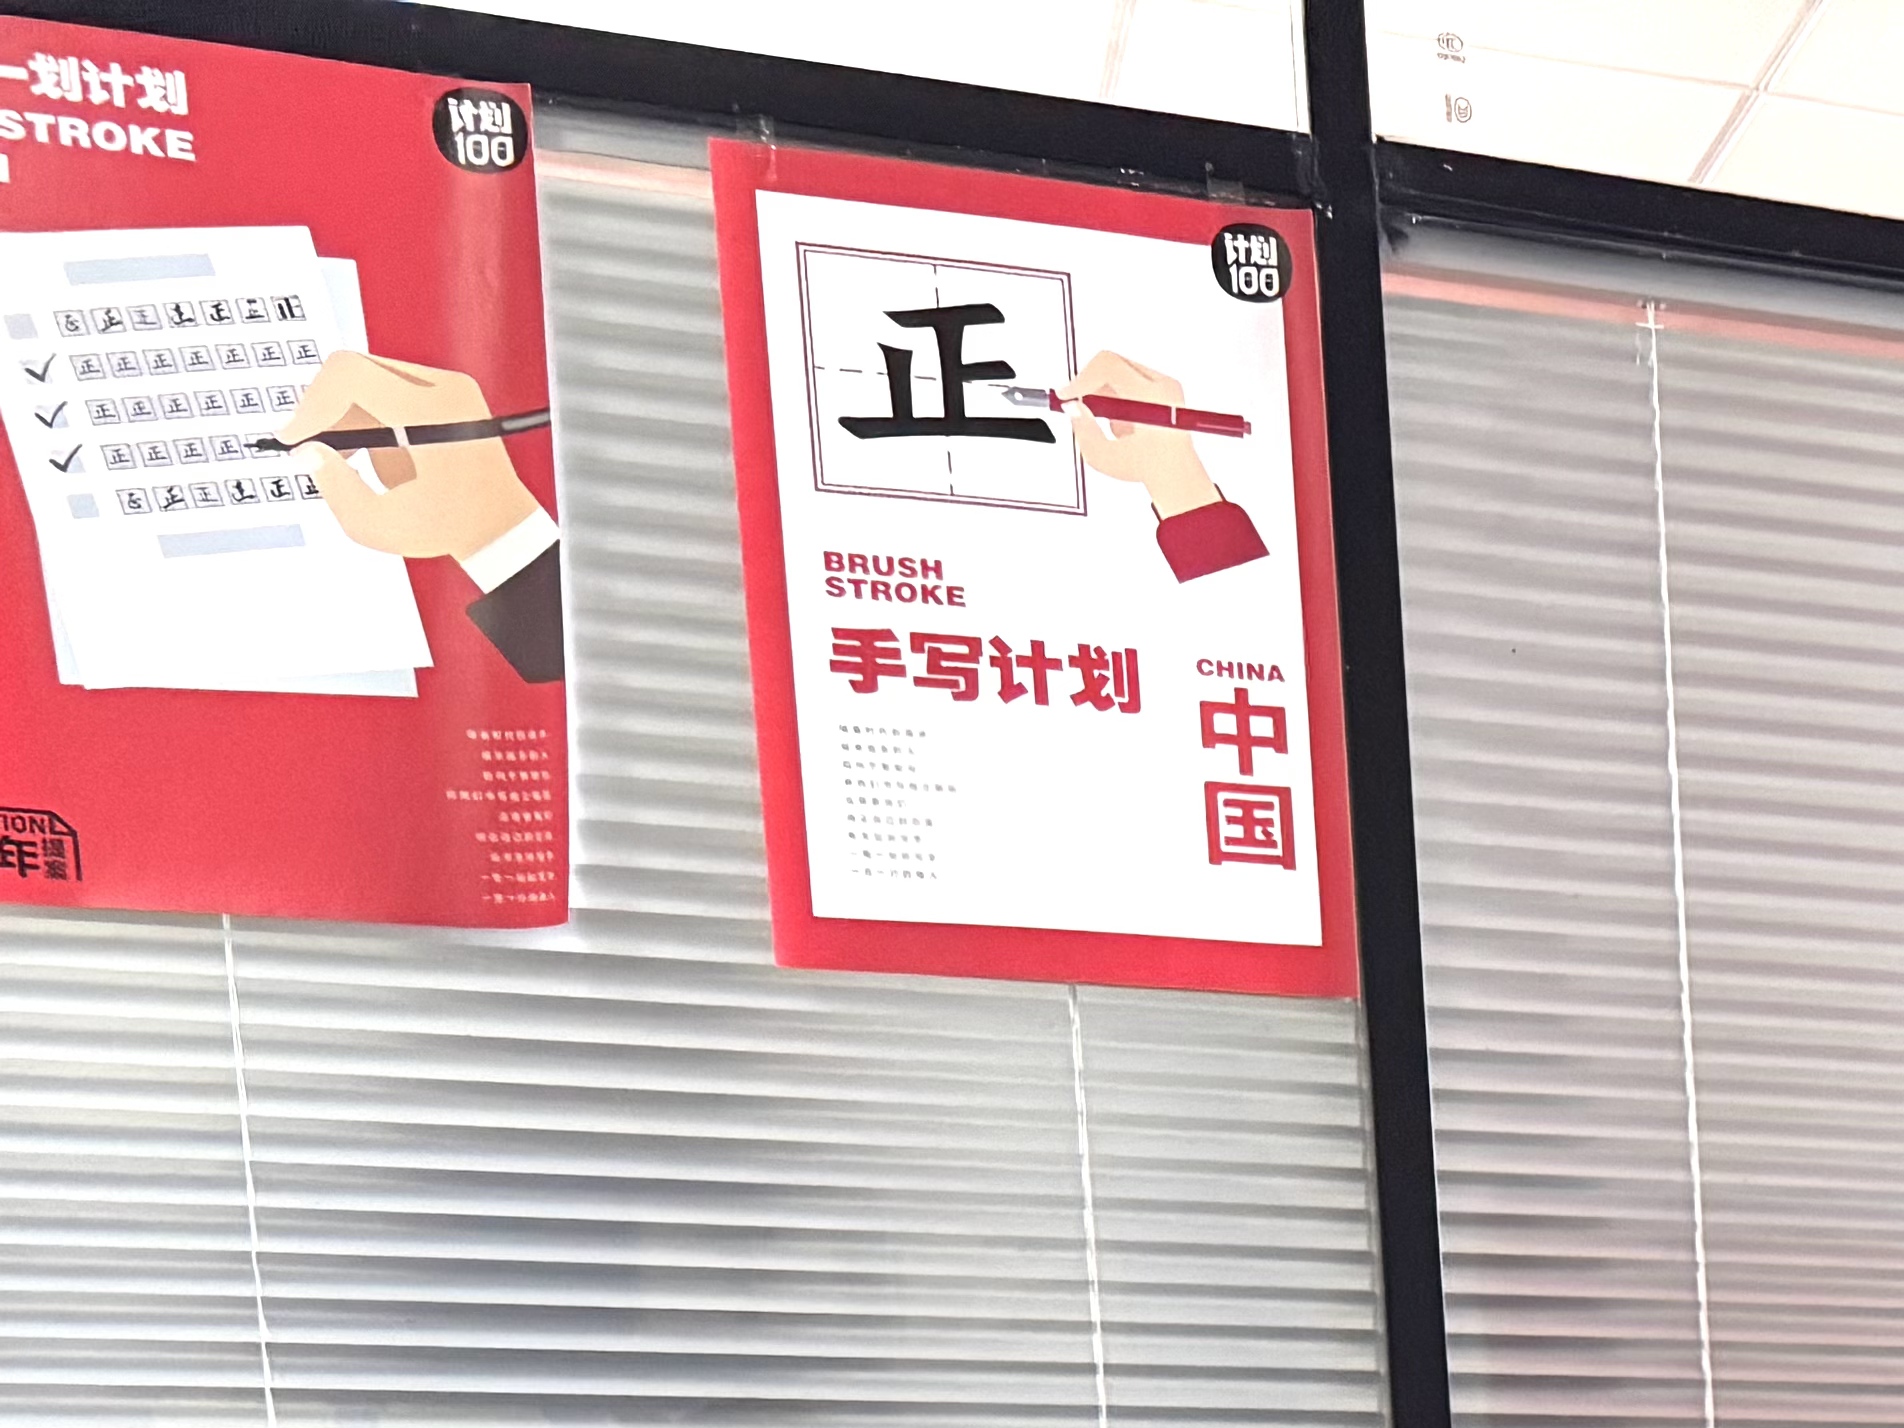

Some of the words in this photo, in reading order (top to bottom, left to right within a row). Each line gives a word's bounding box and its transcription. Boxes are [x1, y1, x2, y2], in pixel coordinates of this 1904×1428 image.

[447, 97, 512, 134] 计划
[0, 109, 196, 161] STROKE
[455, 132, 514, 167] 100
[1224, 233, 1278, 266] 计划
[1229, 264, 1280, 297] 100
[838, 303, 1056, 444] 正
[824, 551, 943, 580] BRUSH
[825, 576, 966, 607] STROKE
[830, 627, 1141, 714] 手写计划
[1196, 659, 1285, 682] CHINA
[1200, 687, 1296, 870] 中国
[0, 815, 46, 834] ION
